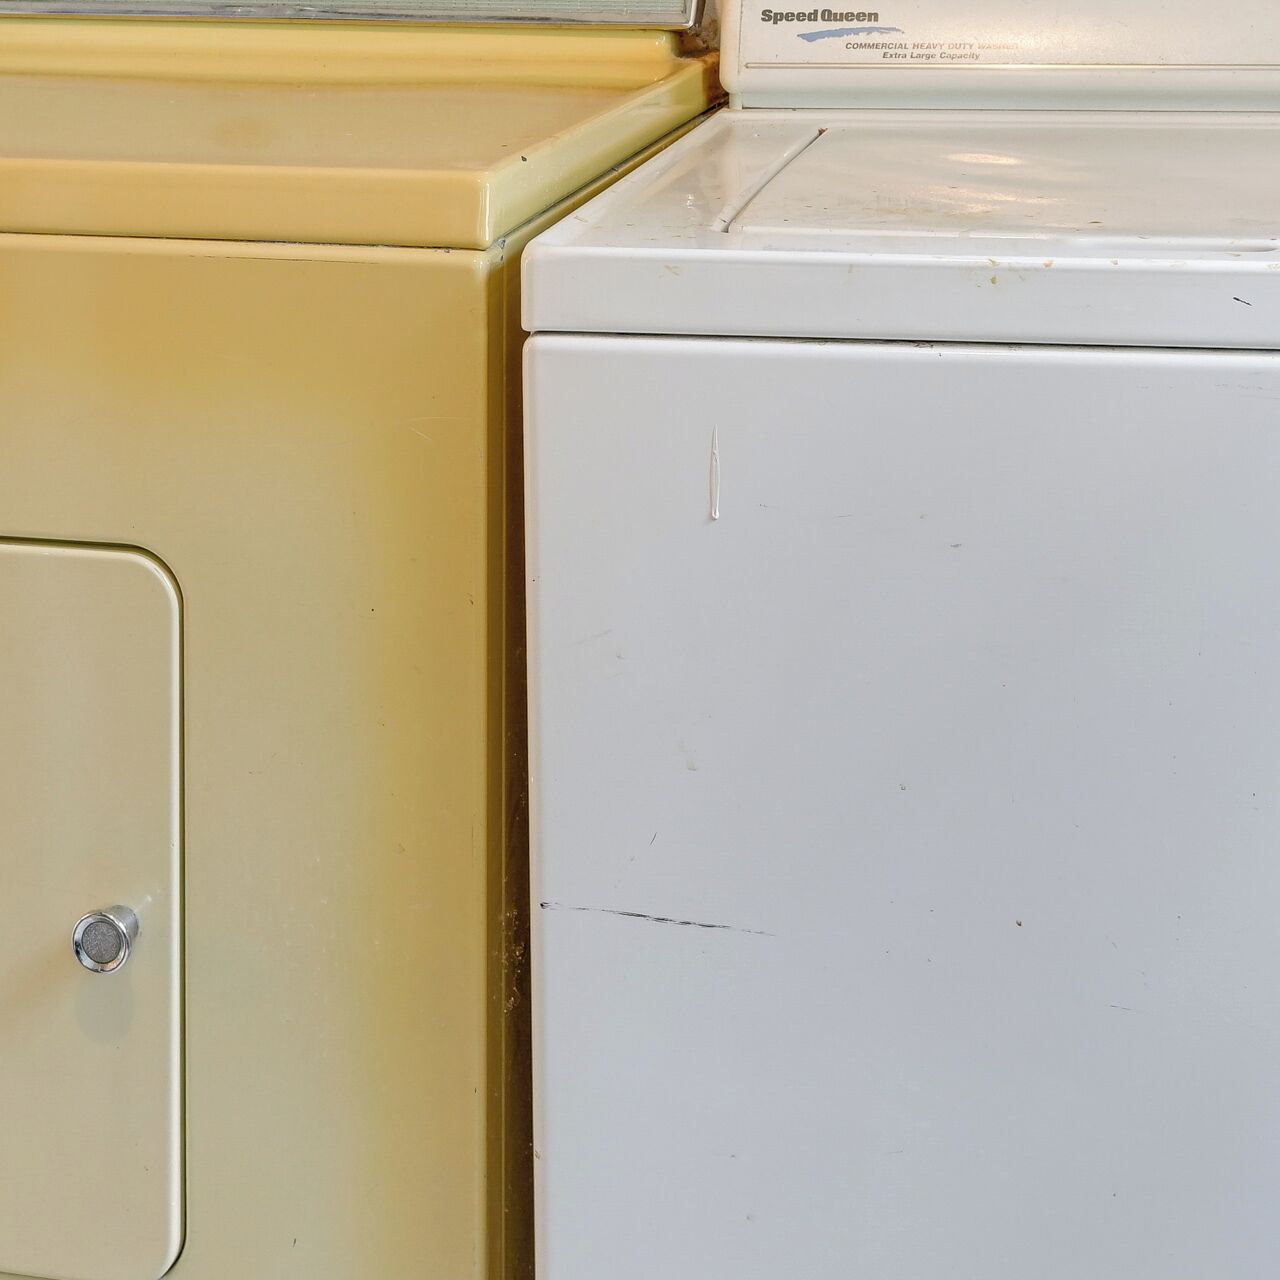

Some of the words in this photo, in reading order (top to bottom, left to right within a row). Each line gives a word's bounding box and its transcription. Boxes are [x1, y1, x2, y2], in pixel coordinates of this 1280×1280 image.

[761, 9, 818, 24] Speed
[820, 9, 879, 22] Queen
[910, 52, 936, 60] Large
[940, 52, 980, 60] Capacity
